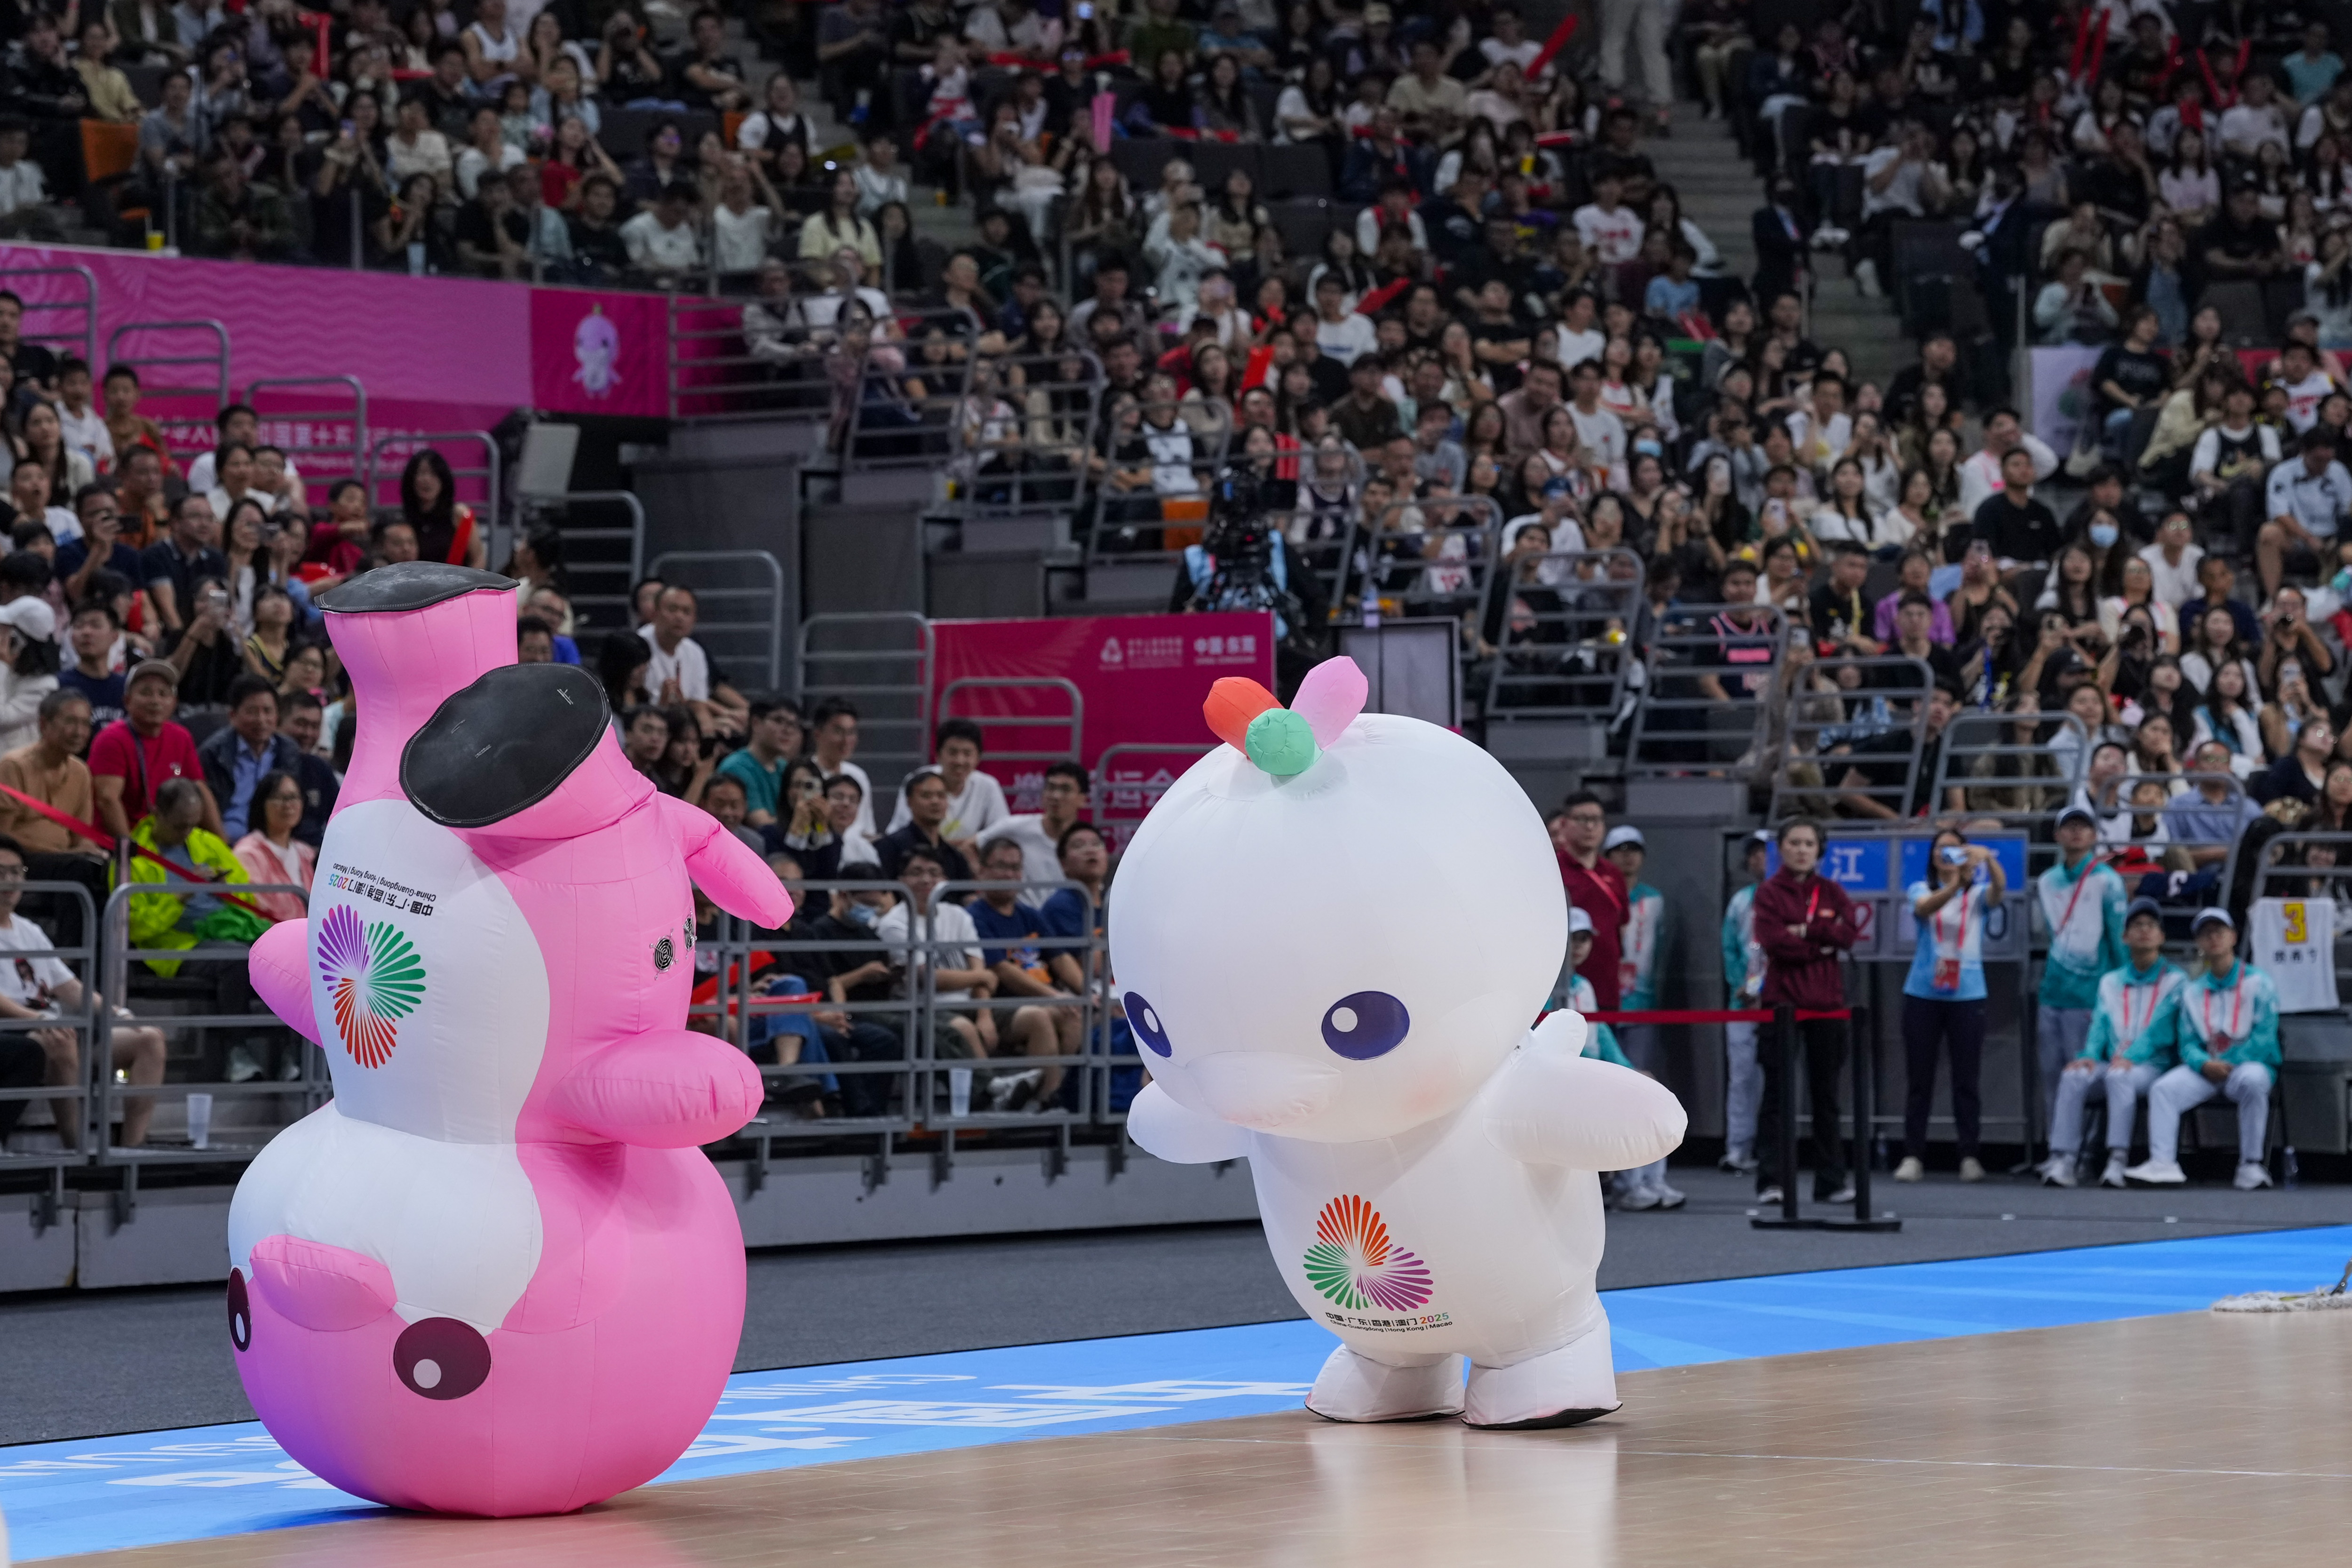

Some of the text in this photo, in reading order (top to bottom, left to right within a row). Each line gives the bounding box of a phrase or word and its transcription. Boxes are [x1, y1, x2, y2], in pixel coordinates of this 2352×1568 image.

[333, 863, 348, 874] Macao
[350, 866, 363, 878] Kong
[328, 873, 349, 890] 2025
[2284, 902, 2308, 943] 3
[1419, 1312, 1449, 1324] 2025
[1429, 1321, 1453, 1330] Macao
